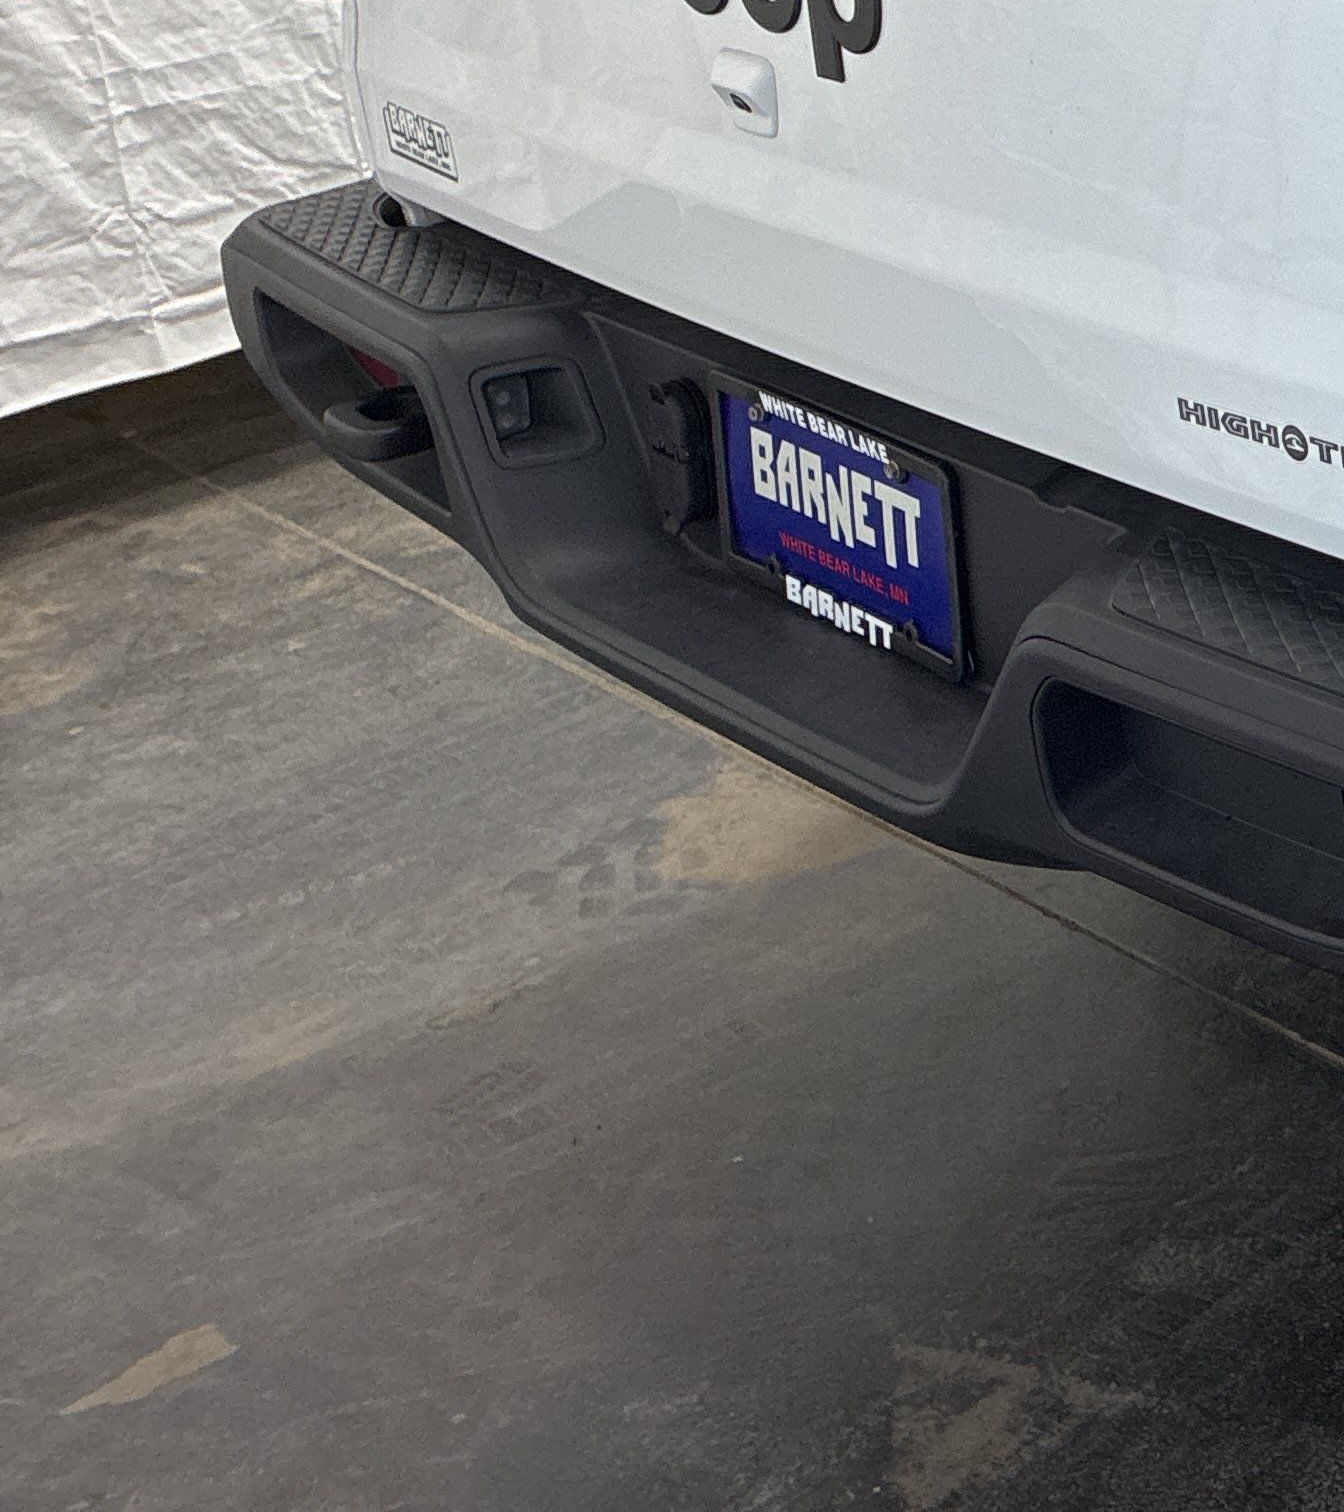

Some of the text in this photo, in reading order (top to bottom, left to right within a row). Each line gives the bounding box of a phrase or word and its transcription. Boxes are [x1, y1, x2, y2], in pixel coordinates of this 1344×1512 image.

[386, 101, 450, 159] BARNETT
[759, 390, 890, 465] WHITE BEAR LAKE
[1177, 397, 1280, 449] HIGH
[750, 426, 921, 569] BARNETT
[779, 530, 817, 562] WHITE
[817, 550, 851, 578] BEAR
[785, 574, 893, 650] BARNETT
